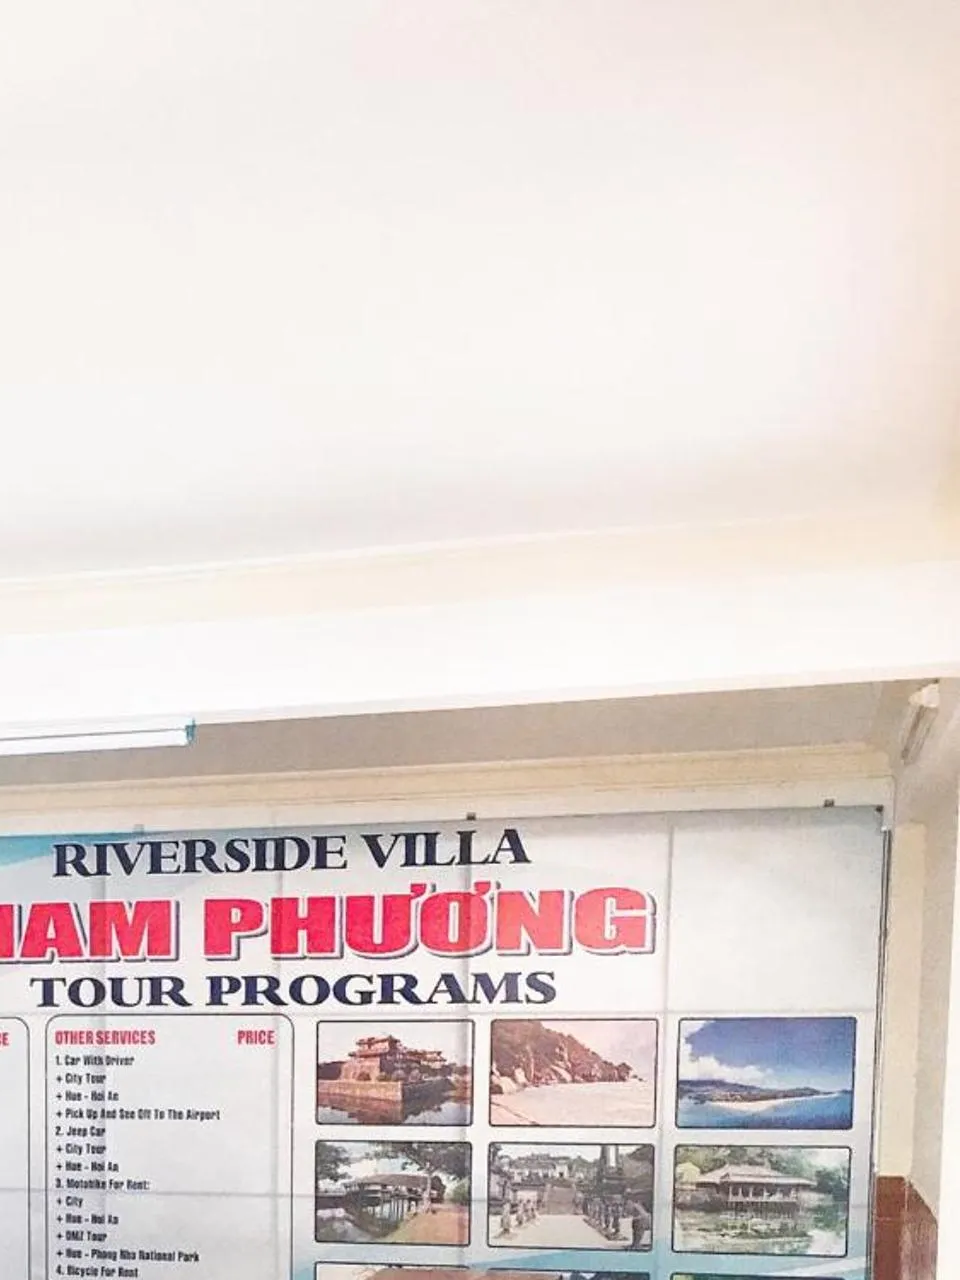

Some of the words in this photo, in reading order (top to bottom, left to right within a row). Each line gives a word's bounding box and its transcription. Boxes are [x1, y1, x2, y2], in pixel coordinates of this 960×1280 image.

[53, 834, 348, 877] RIVERSIDE
[363, 827, 532, 870] VILLA
[203, 880, 657, 961] PHƯƠNG
[30, 976, 192, 1008] TOUR
[206, 970, 558, 1006] PROGRAMS
[55, 1031, 94, 1045] OTHER
[96, 1030, 156, 1045] SERVICES
[237, 1030, 275, 1044] PRICE
[64, 1055, 81, 1066] Car
[83, 1055, 104, 1066] With
[105, 1055, 135, 1066] Driver
[65, 1073, 83, 1085] City
[85, 1073, 107, 1084] Tour
[65, 1091, 82, 1101] Hue
[91, 1091, 105, 1101] Hoi
[107, 1091, 119, 1101] An
[65, 1108, 84, 1119] Pick
[86, 1109, 97, 1120] Up
[100, 1109, 117, 1119] And
[119, 1109, 135, 1119] See
[137, 1109, 151, 1119] Off
[154, 1109, 165, 1119] To
[167, 1109, 184, 1120] The
[186, 1110, 220, 1121] Airport
[55, 1126, 64, 1136] 2.
[66, 1126, 87, 1137] Jeep
[90, 1126, 106, 1136] Car
[65, 1143, 83, 1155] City
[85, 1143, 107, 1154] Tour
[65, 1161, 82, 1171] Hue
[91, 1161, 105, 1172] Hoi
[107, 1162, 119, 1172] An
[55, 1178, 64, 1188] 3.
[109, 1179, 124, 1189] For
[65, 1196, 83, 1207] City
[65, 1213, 82, 1224] Hue
[91, 1214, 105, 1224] Hoi
[107, 1214, 119, 1224] An
[65, 1230, 83, 1241] DMZ
[86, 1231, 107, 1241] Tour
[65, 1248, 82, 1258] Hue
[91, 1249, 117, 1261] Phong
[120, 1249, 136, 1260] Nha
[139, 1250, 175, 1261] National
[178, 1251, 199, 1262] Park
[56, 1265, 64, 1275] 4.
[67, 1265, 98, 1277] Bicycle
[100, 1266, 116, 1277] For
[118, 1267, 138, 1277] Rent
